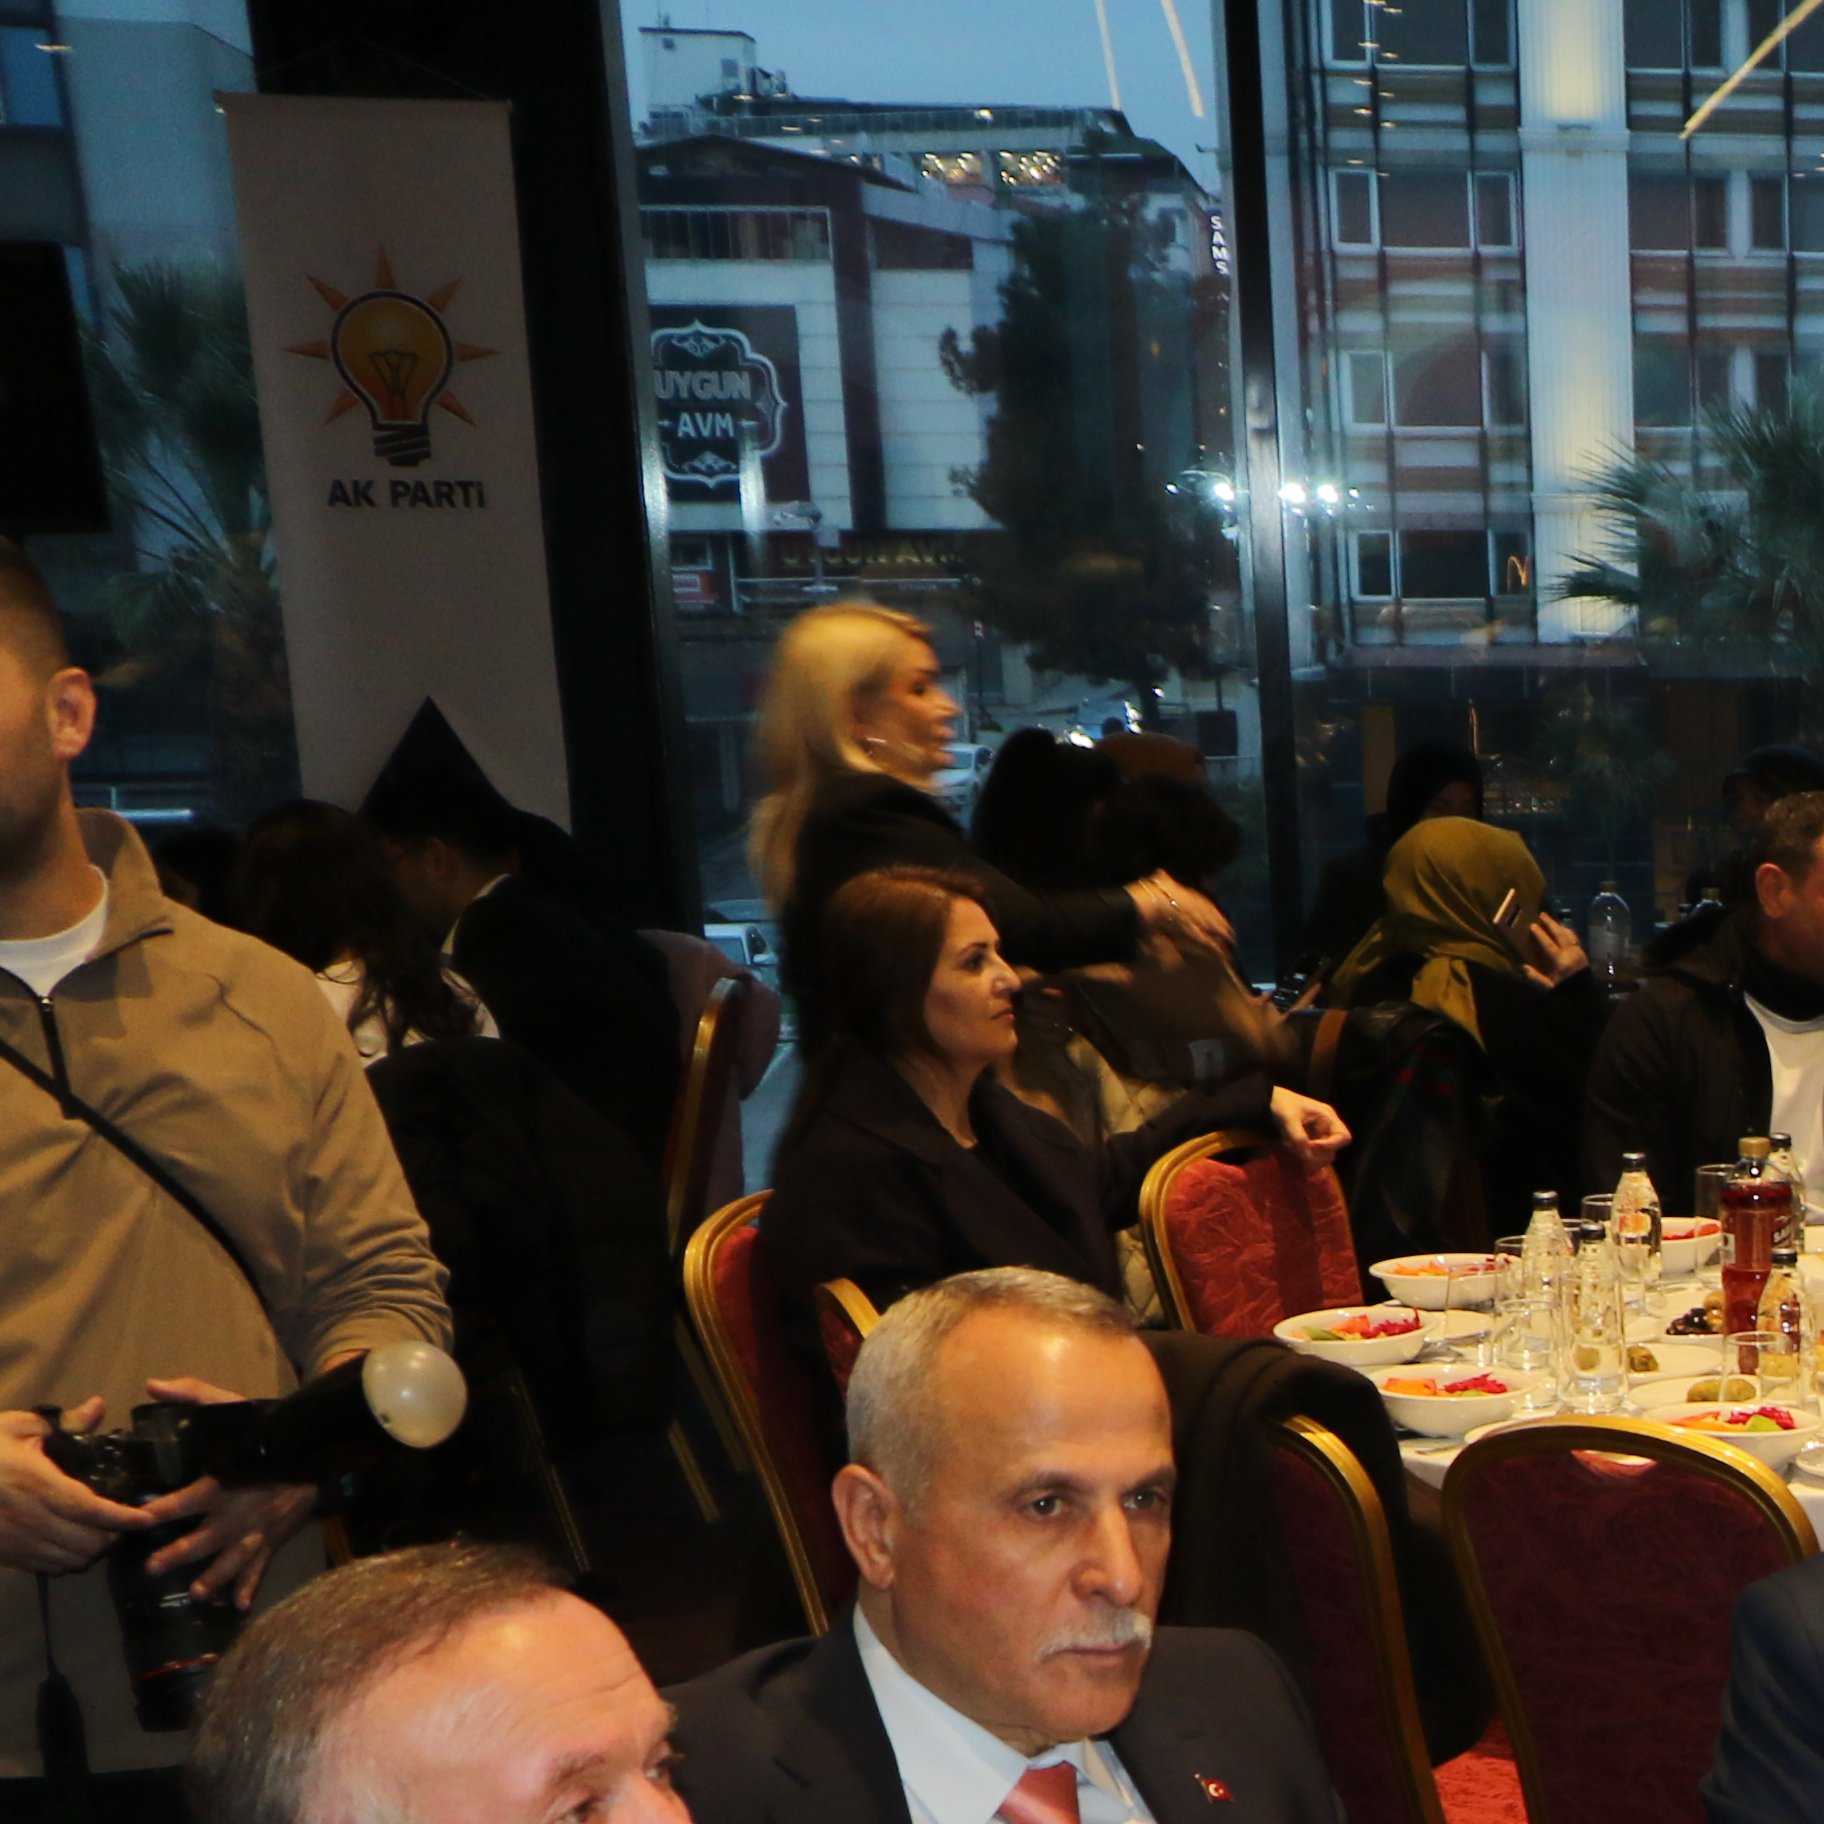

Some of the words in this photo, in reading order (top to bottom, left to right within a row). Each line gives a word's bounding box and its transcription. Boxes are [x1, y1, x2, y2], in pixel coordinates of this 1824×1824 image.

[654, 370, 752, 401] UYGUN
[677, 412, 734, 438] AVM
[329, 479, 376, 508] AK
